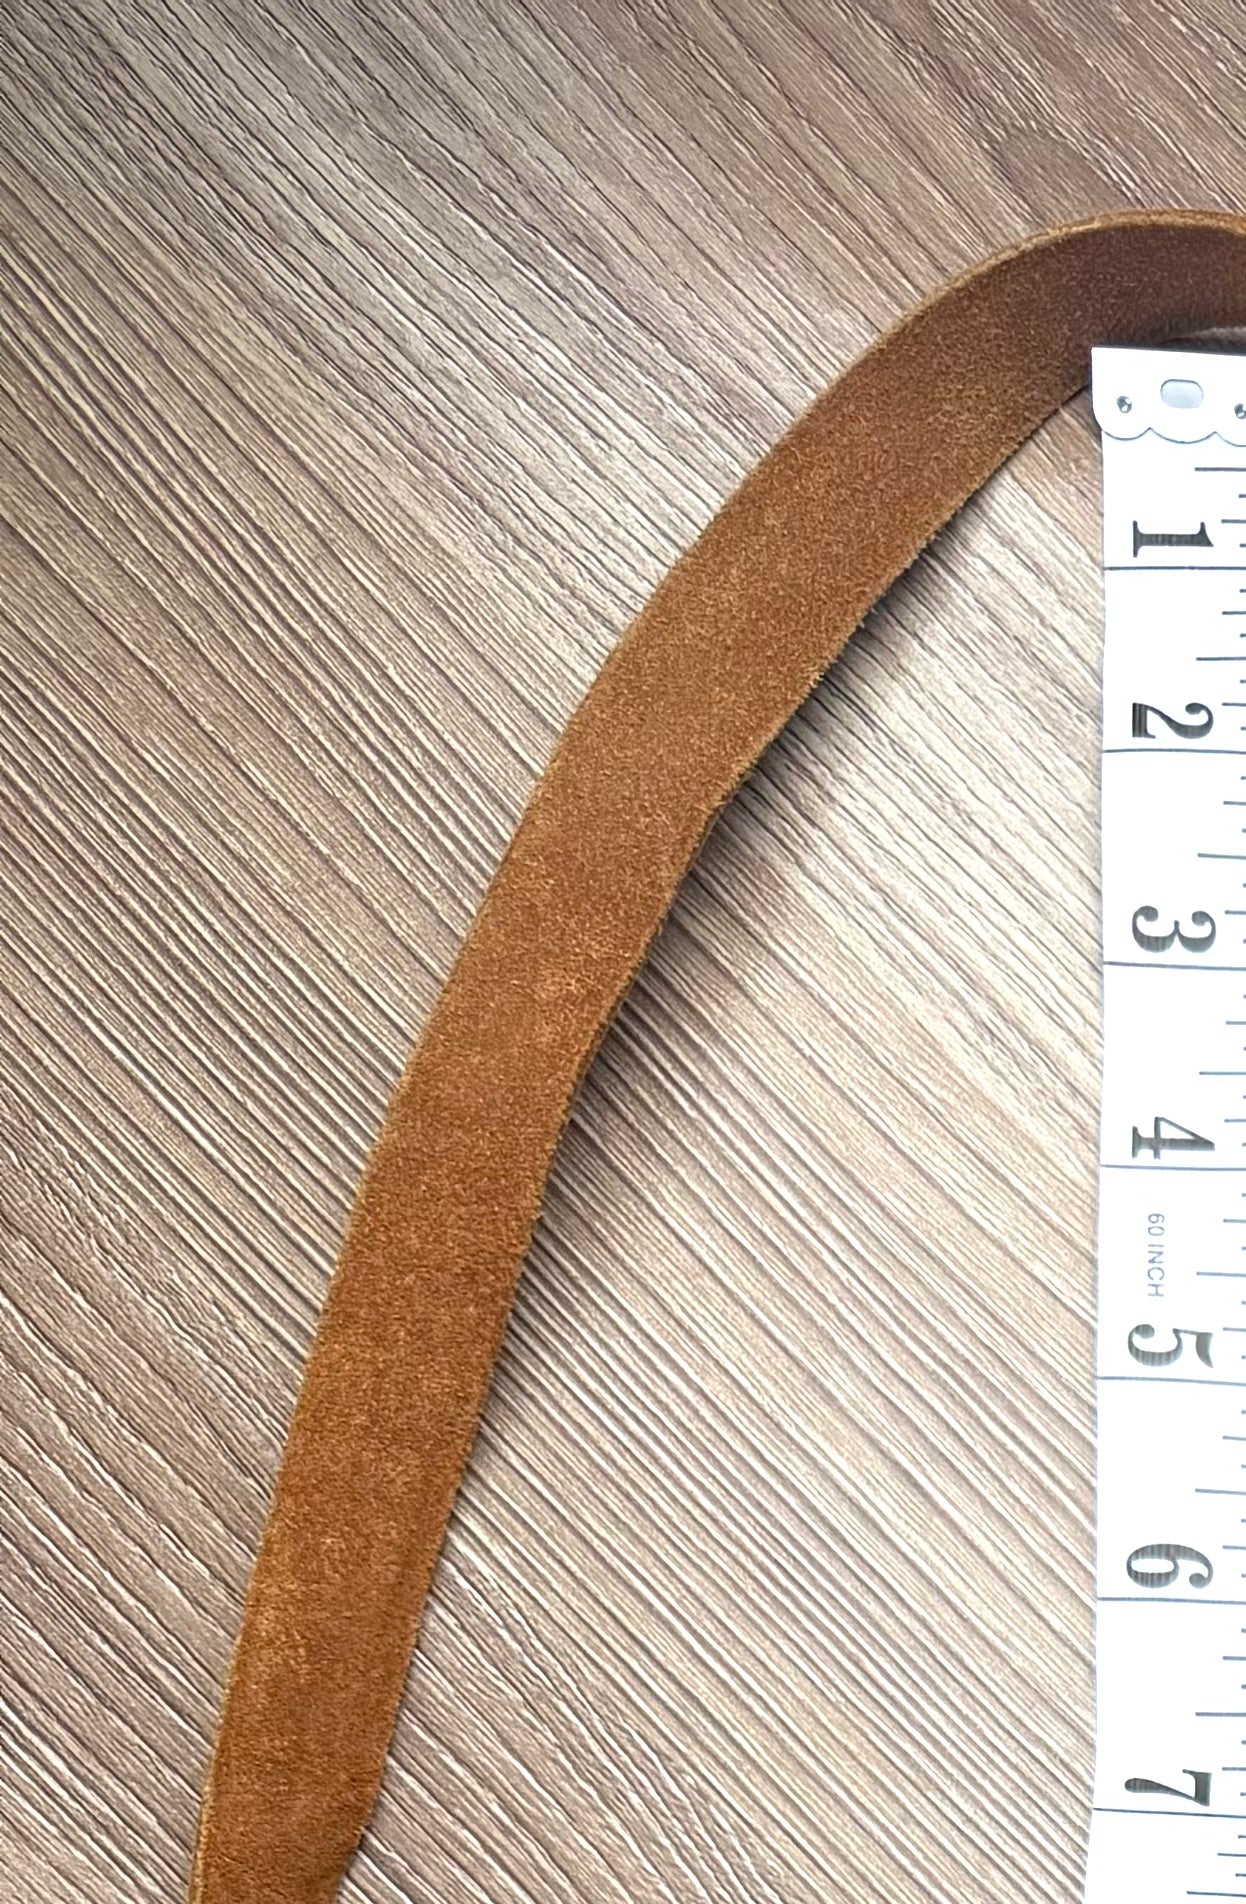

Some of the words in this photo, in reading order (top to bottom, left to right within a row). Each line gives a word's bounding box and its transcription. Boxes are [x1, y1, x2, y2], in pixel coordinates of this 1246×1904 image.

[1133, 521, 1213, 557] 1
[1132, 703, 1213, 738] 2
[1132, 906, 1215, 951] 3
[1132, 1117, 1214, 1158] 4
[1148, 1213, 1165, 1236] 60
[1147, 1244, 1165, 1297] INCH
[1128, 1324, 1211, 1364] 5
[1127, 1544, 1212, 1587] 6
[1125, 1769, 1211, 1806] 7
